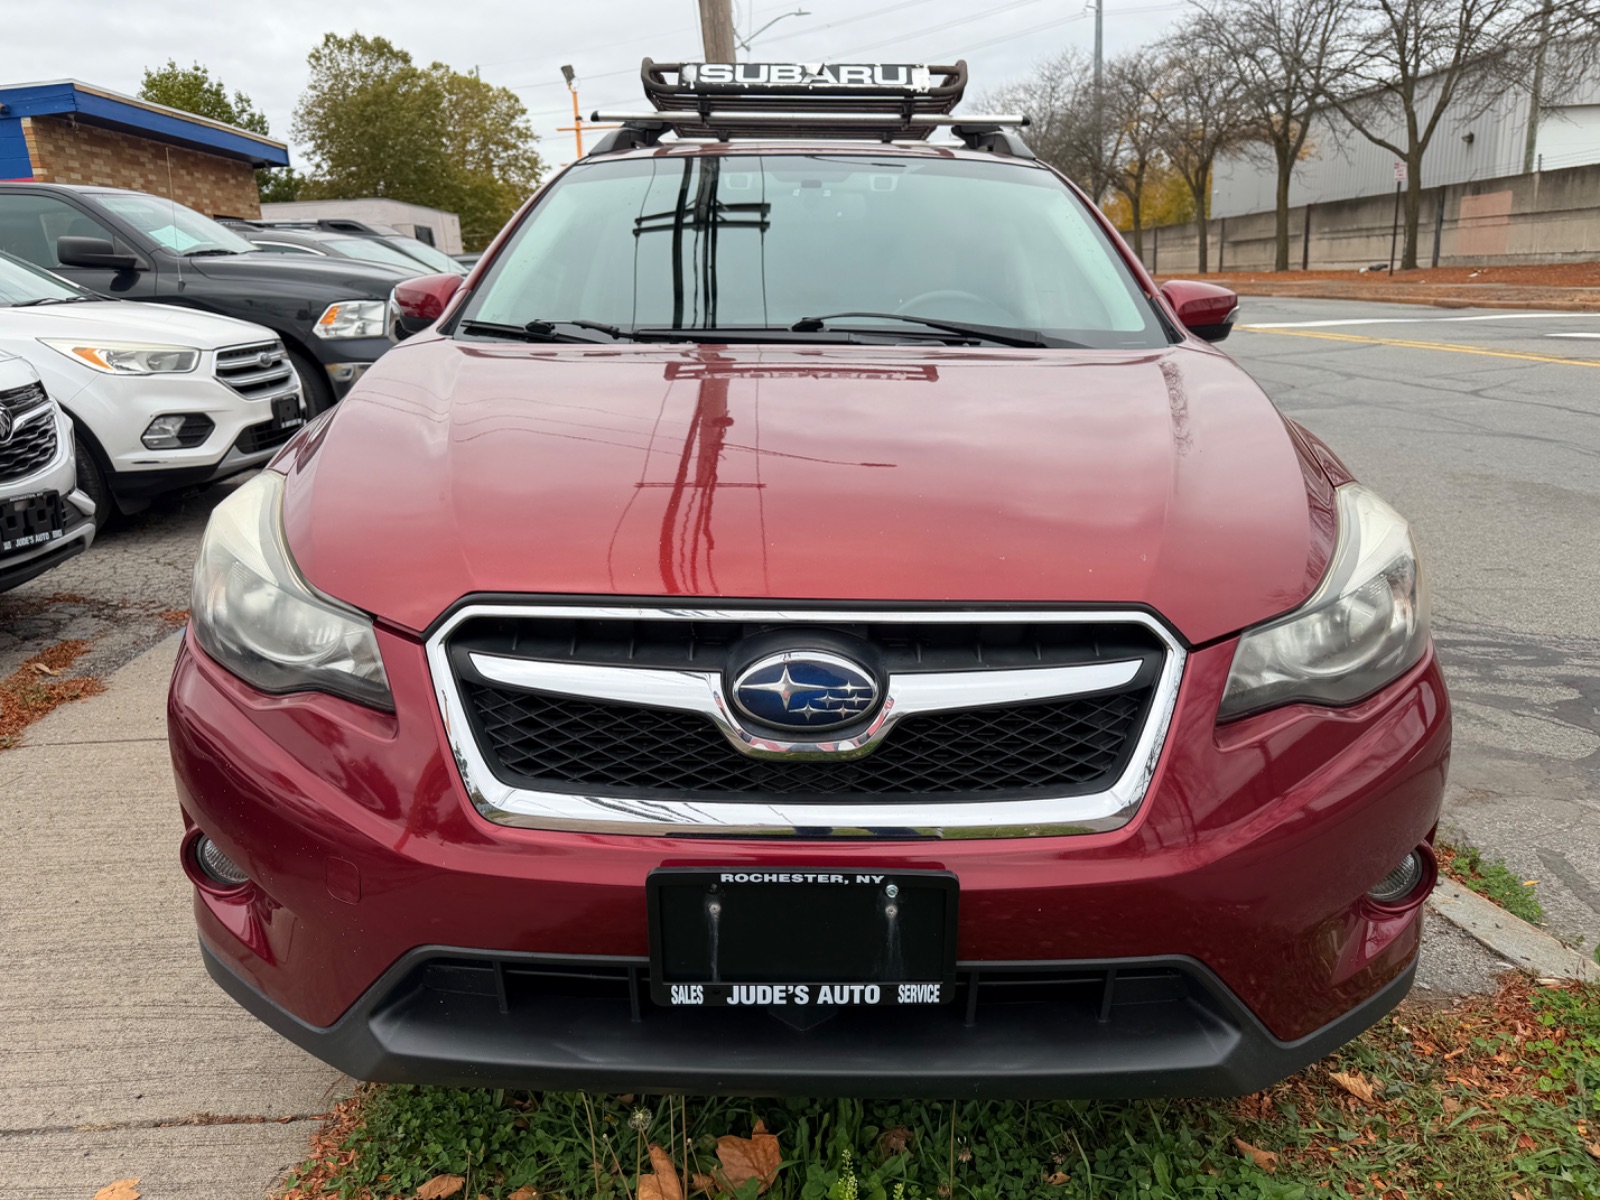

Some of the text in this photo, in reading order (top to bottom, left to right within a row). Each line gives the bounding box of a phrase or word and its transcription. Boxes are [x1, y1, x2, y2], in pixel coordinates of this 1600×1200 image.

[699, 64, 908, 85] SUBARU
[720, 873, 885, 885] ROCHESTER, NY
[670, 983, 940, 1006] SALES JUDE'S AUTO SERVICE
